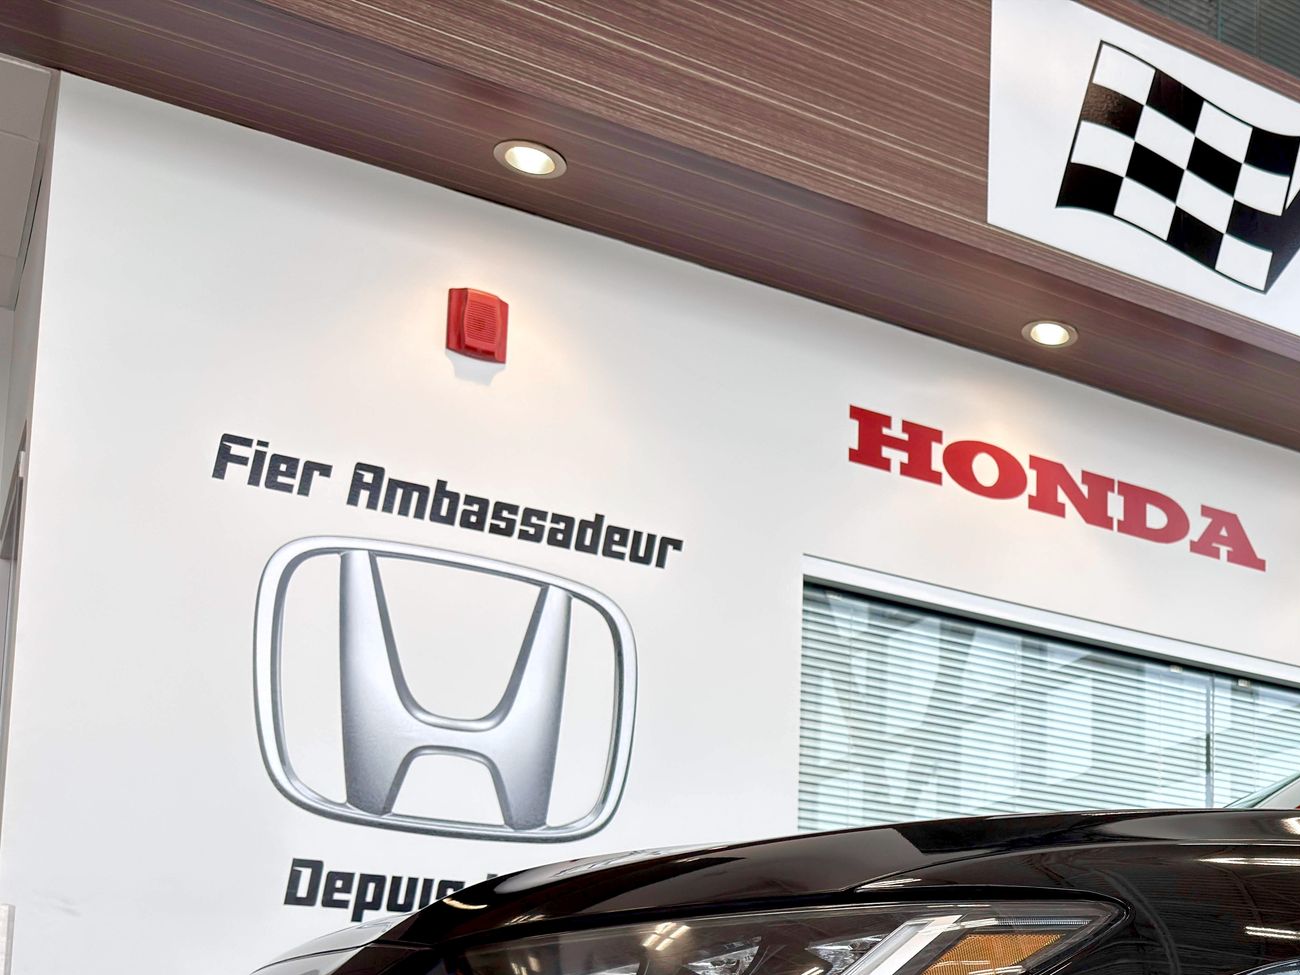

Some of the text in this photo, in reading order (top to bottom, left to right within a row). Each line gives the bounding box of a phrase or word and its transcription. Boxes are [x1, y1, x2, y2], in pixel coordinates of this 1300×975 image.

[212, 433, 683, 570] Fier Ambassadeur
[848, 404, 1266, 572] HONDA
